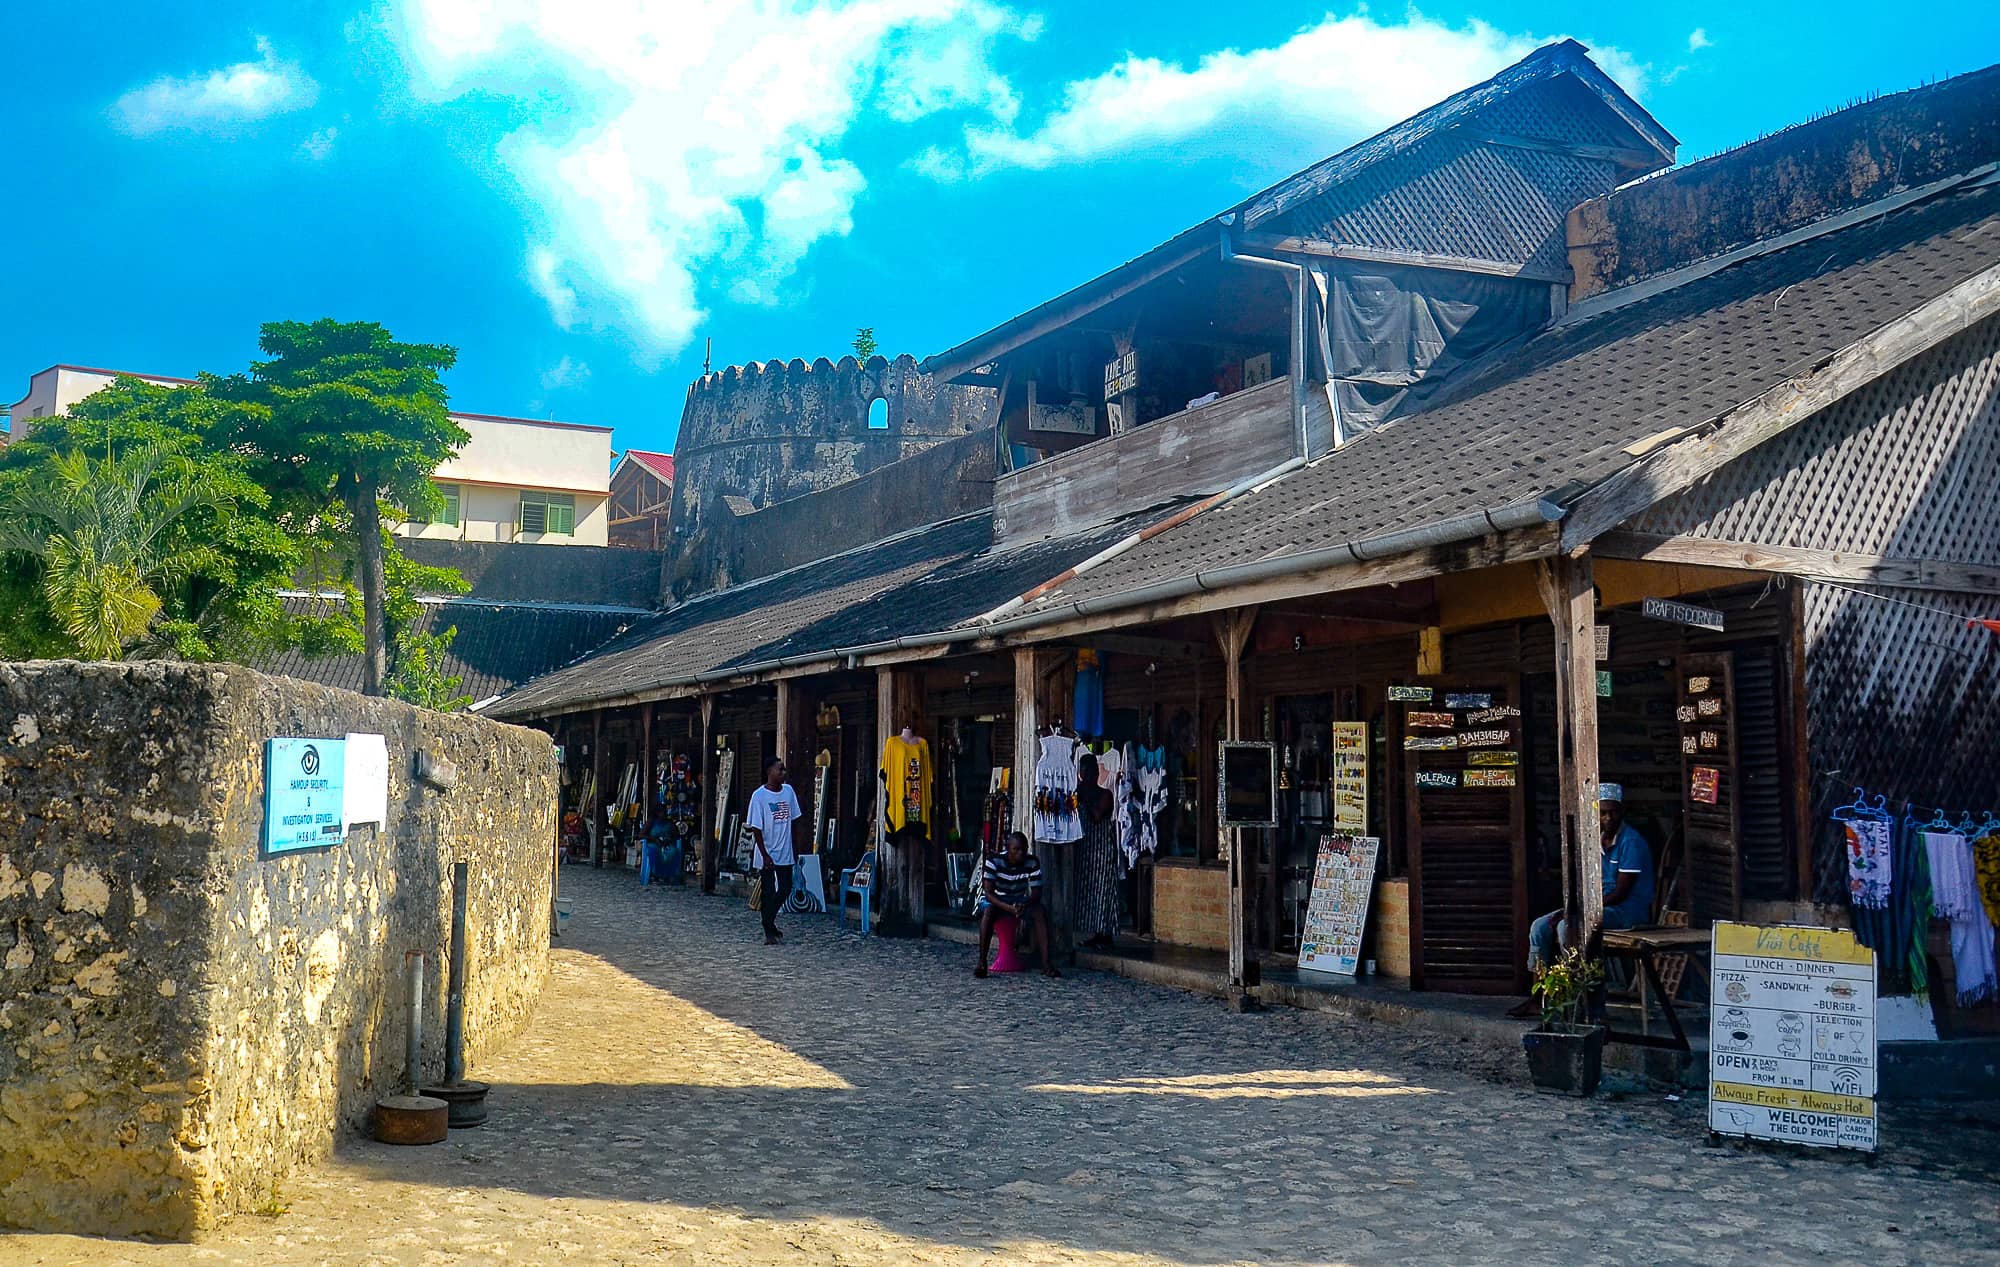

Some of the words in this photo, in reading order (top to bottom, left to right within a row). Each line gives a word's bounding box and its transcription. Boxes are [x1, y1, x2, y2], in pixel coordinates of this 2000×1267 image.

[1123, 351, 1135, 375] ART
[1646, 599, 1684, 620] CRAFTS
[1295, 636, 1300, 650] 5
[1459, 730, 1510, 745] ЗАНЗИБАР
[311, 779, 328, 789] SECURITY
[282, 814, 313, 826] INVESTIGATION
[315, 813, 333, 825] SERVICES
[1745, 959, 1784, 971] LUNCH
[1796, 963, 1835, 974] DINNER
[1816, 1015, 1862, 1027] SELECTION
[1833, 1032, 1845, 1040] OF
[1717, 1054, 1750, 1069] OPEN
[1760, 1058, 1777, 1066] DAYS
[1814, 1052, 1835, 1061] COLD
[1839, 1055, 1868, 1065] DRINKS
[1752, 1073, 1775, 1083] FROM
[1830, 1081, 1862, 1095] WiFi
[1713, 1085, 1753, 1102] Always
[1757, 1090, 1788, 1104] Fresh
[1801, 1093, 1843, 1112] Always
[1845, 1101, 1864, 1114] Hot
[1768, 1109, 1836, 1127] WELCOME
[1769, 1123, 1788, 1133] THE
[1791, 1125, 1807, 1135] OLD
[1811, 1128, 1836, 1138] FORT
[1838, 1133, 1872, 1143] ACCEPTED
